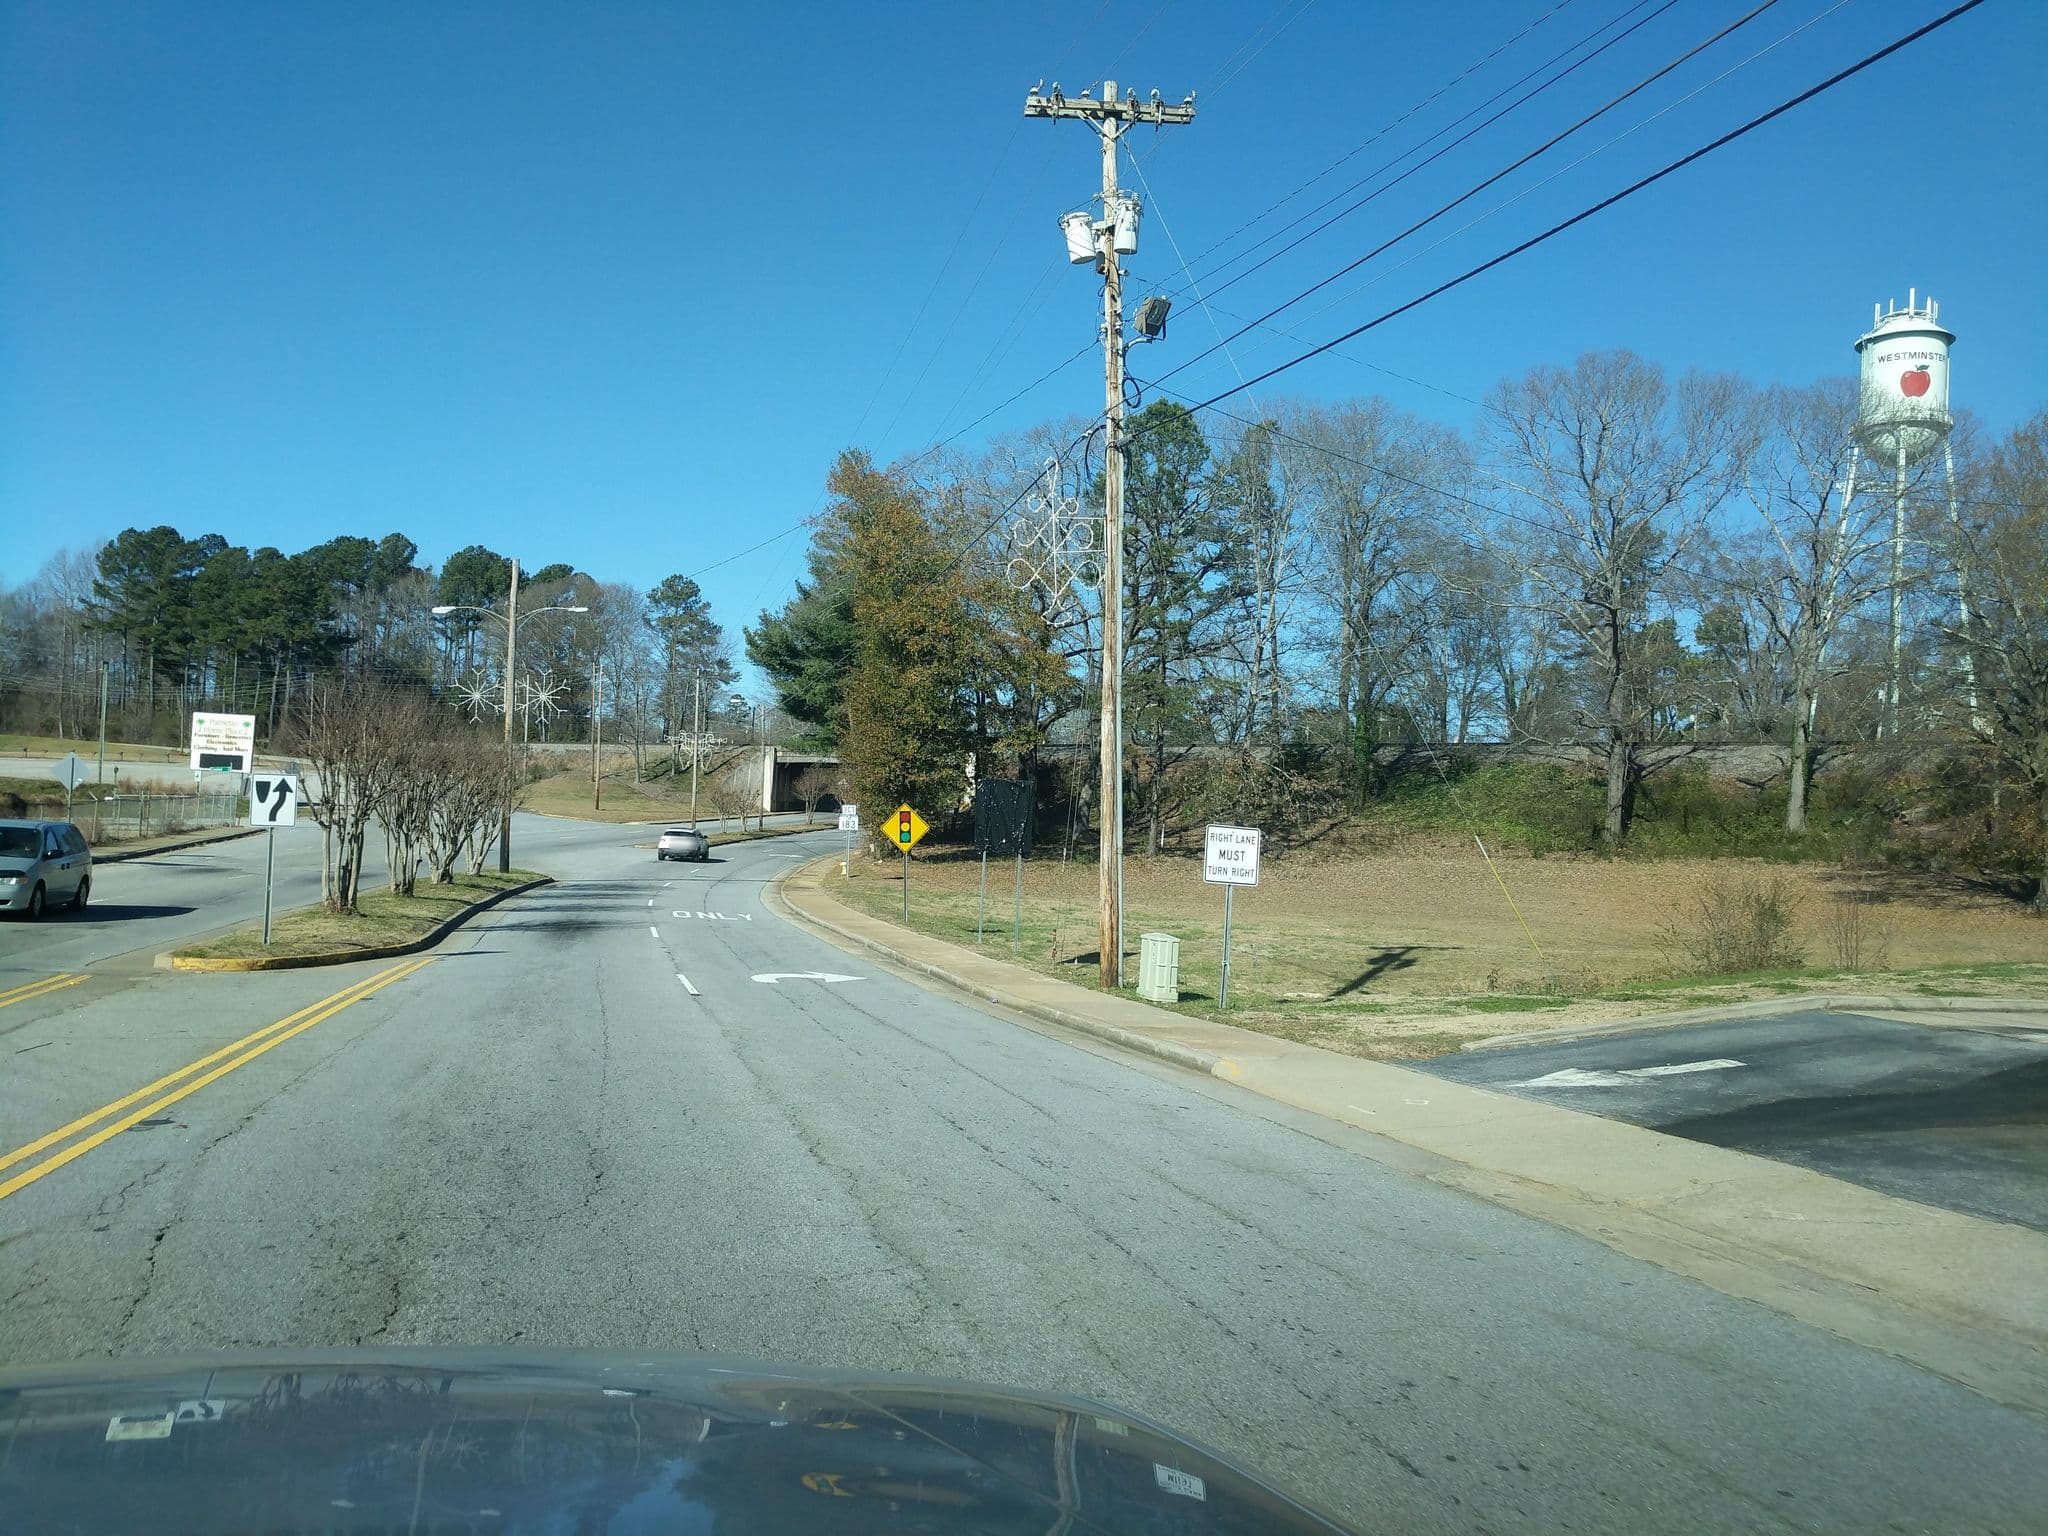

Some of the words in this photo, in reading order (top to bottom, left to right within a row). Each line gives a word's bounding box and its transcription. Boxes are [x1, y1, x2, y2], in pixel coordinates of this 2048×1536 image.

[193, 744, 218, 752] Clothing
[842, 820, 855, 829] 183
[1210, 832, 1233, 843] RIGHT
[1236, 835, 1256, 845] LANE
[1219, 849, 1246, 862] MUST
[1208, 865, 1228, 876] TURN
[1231, 867, 1255, 878] RIGHT
[672, 910, 752, 921] ONLY
